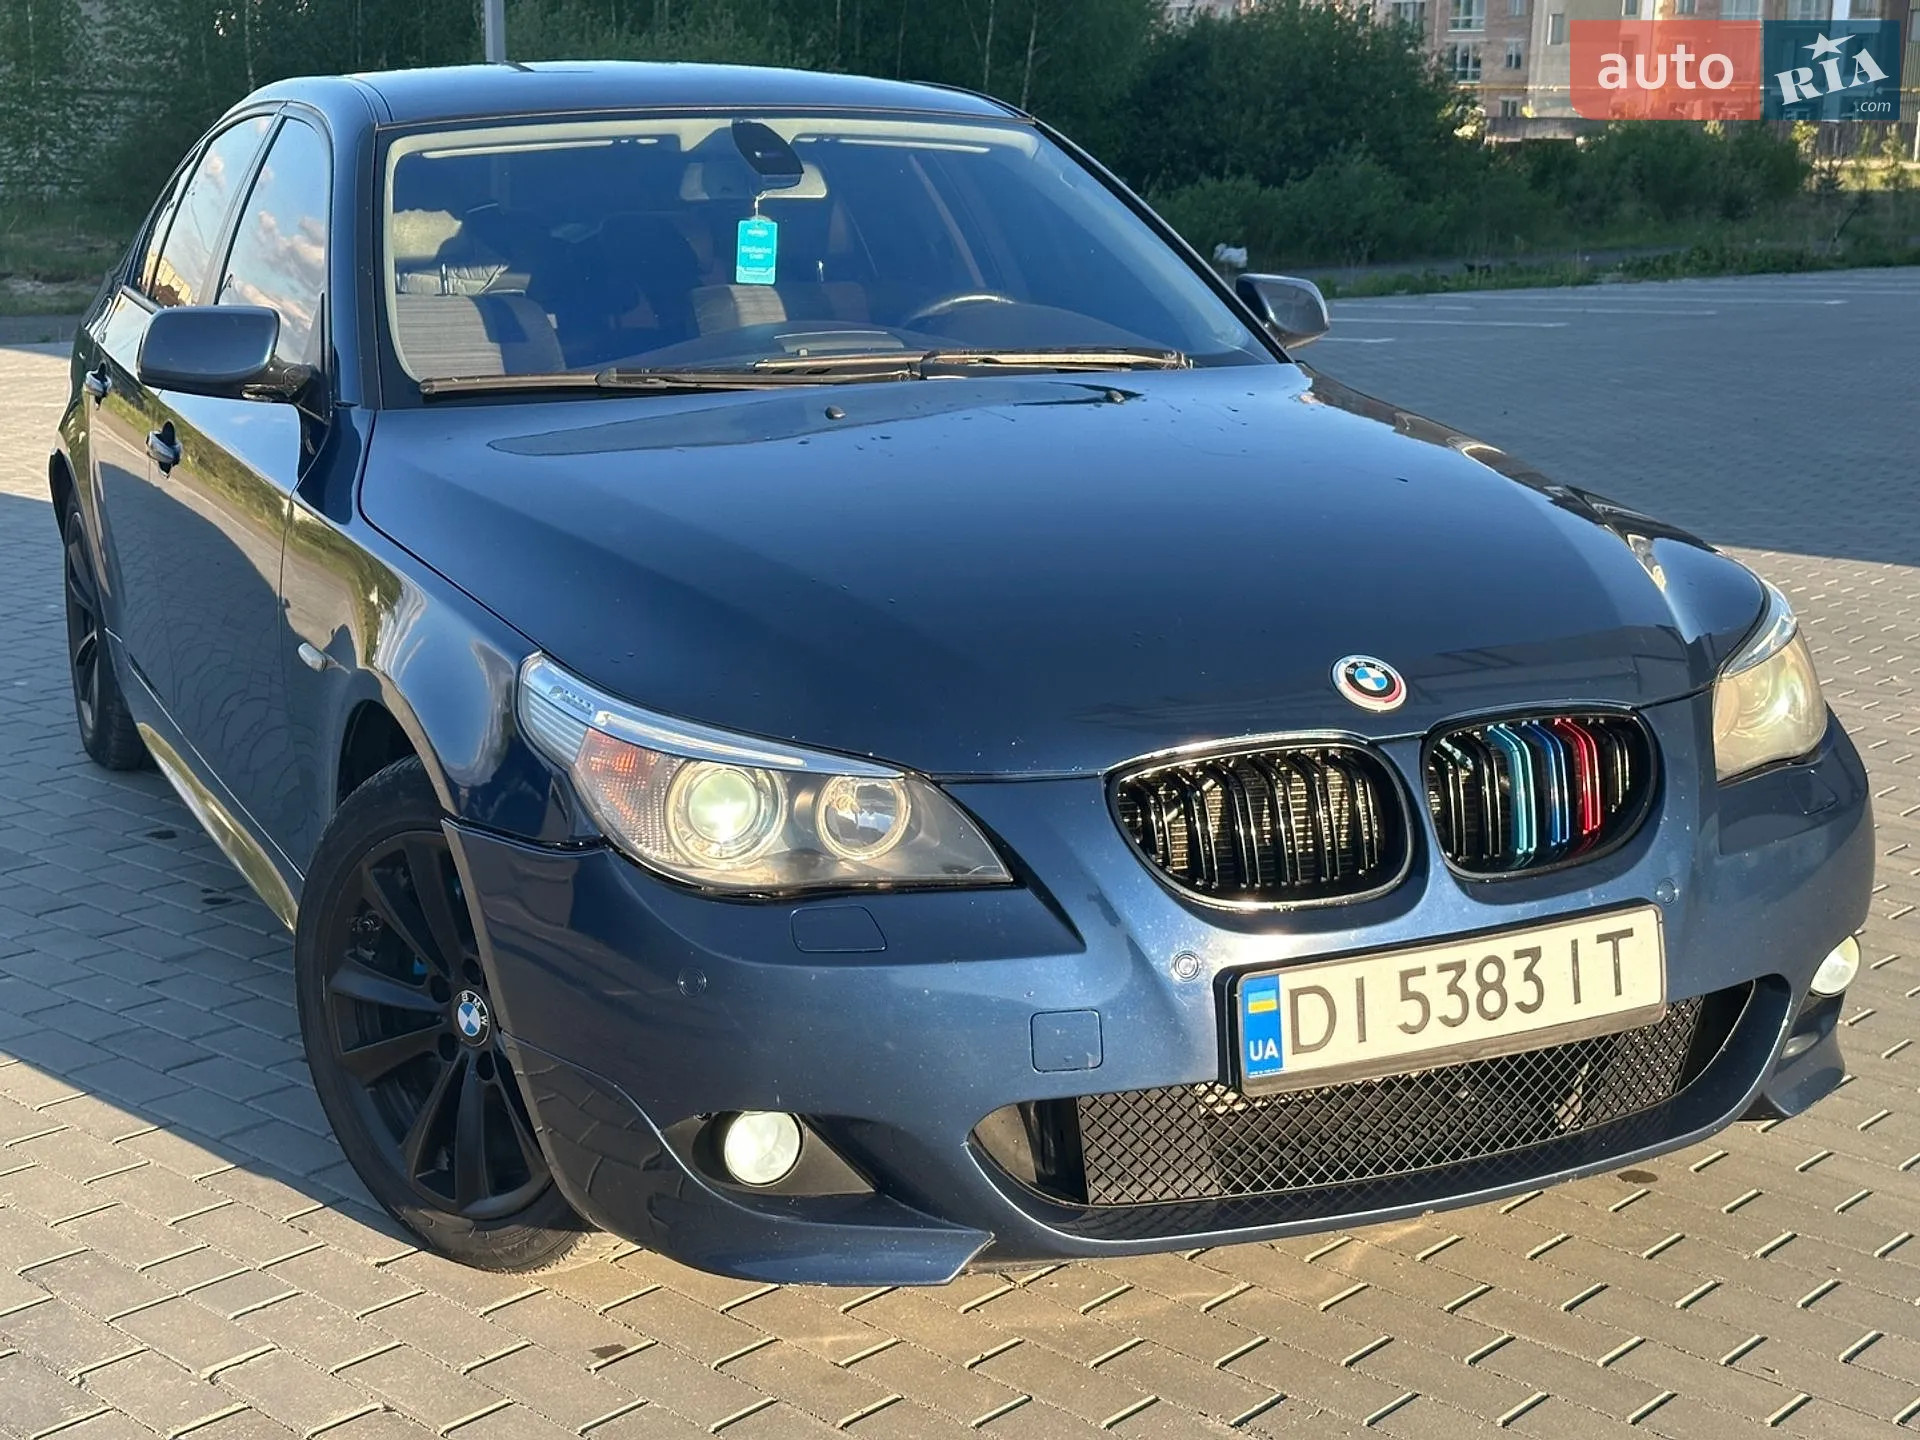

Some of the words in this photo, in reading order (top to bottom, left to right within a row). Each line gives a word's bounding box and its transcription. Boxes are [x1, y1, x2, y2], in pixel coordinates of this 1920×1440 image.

[1288, 976, 1367, 1055] DI
[1397, 945, 1545, 1034] 5383
[1571, 927, 1634, 1005] IT
[1249, 1038, 1279, 1062] UA
